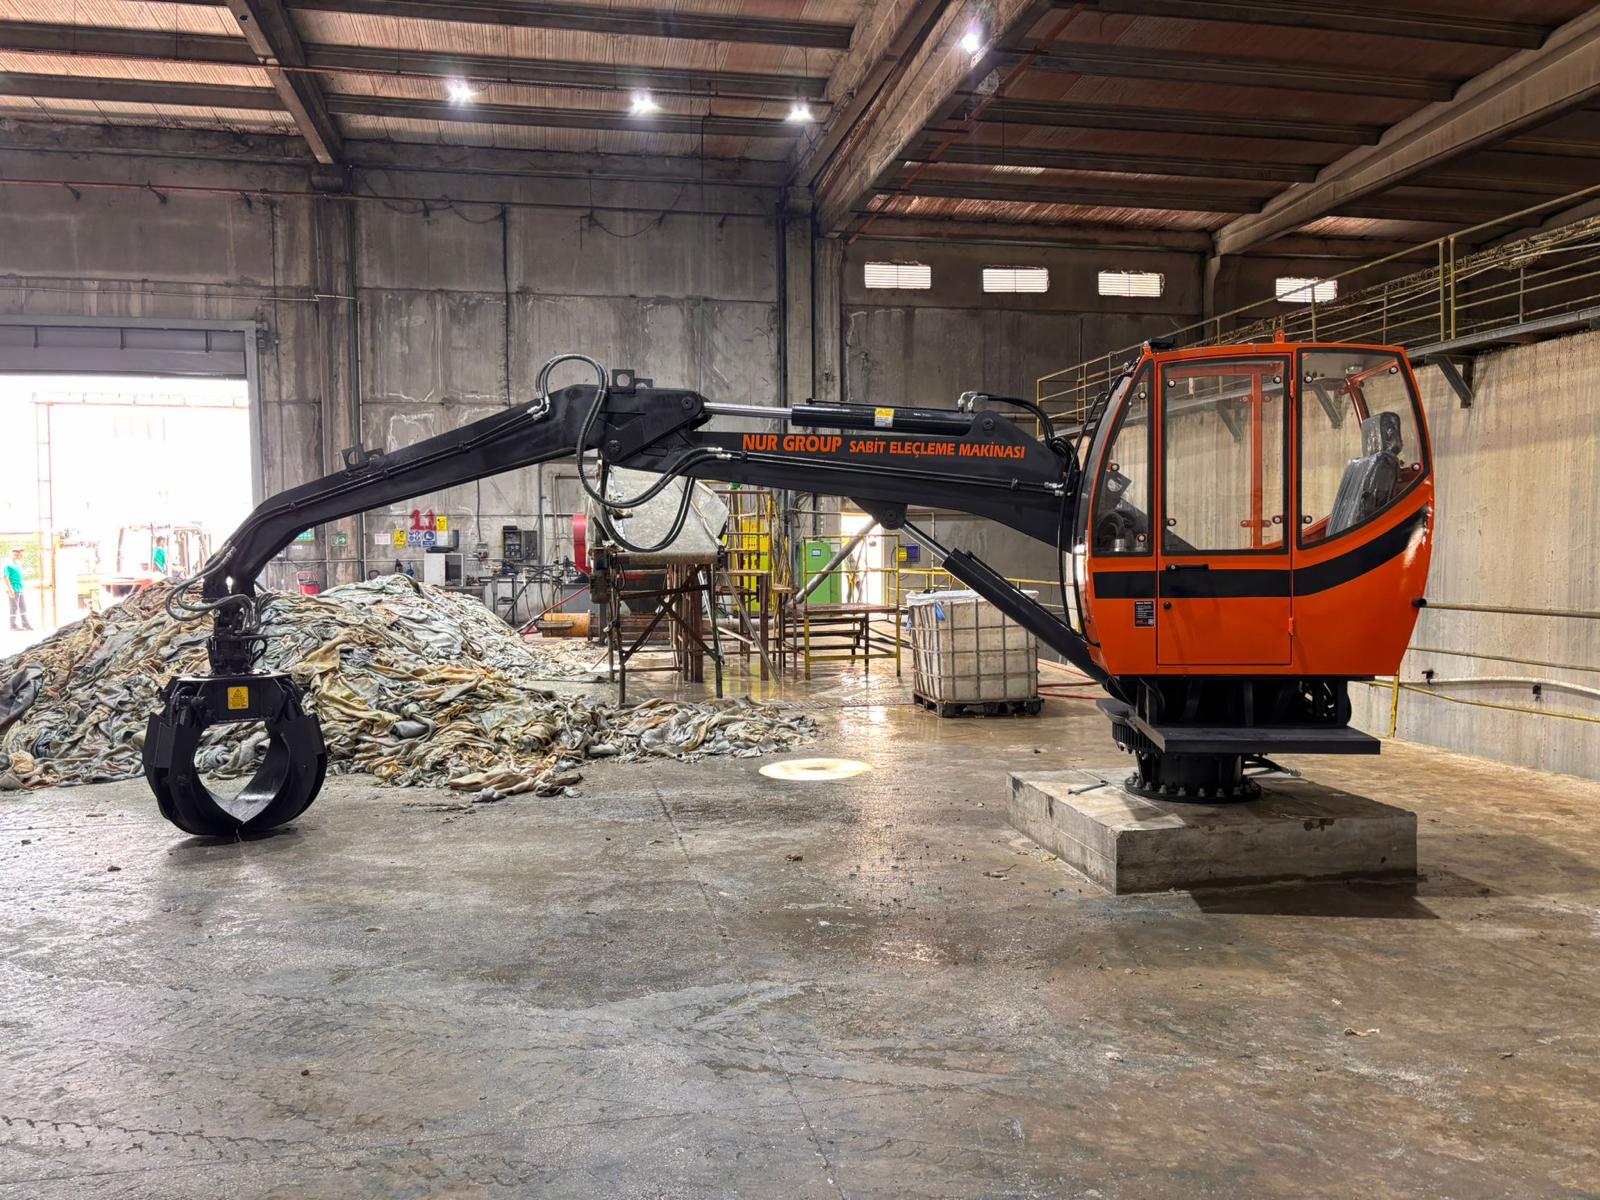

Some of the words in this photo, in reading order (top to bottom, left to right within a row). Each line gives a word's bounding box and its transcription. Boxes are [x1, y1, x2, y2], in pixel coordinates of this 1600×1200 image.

[742, 434, 779, 452] NUR
[782, 435, 843, 454] GROUP
[849, 439, 887, 454] SABİT
[889, 440, 955, 459] ELEÇLEME
[958, 442, 1026, 459] MAKİNASI
[410, 509, 437, 531] 11
